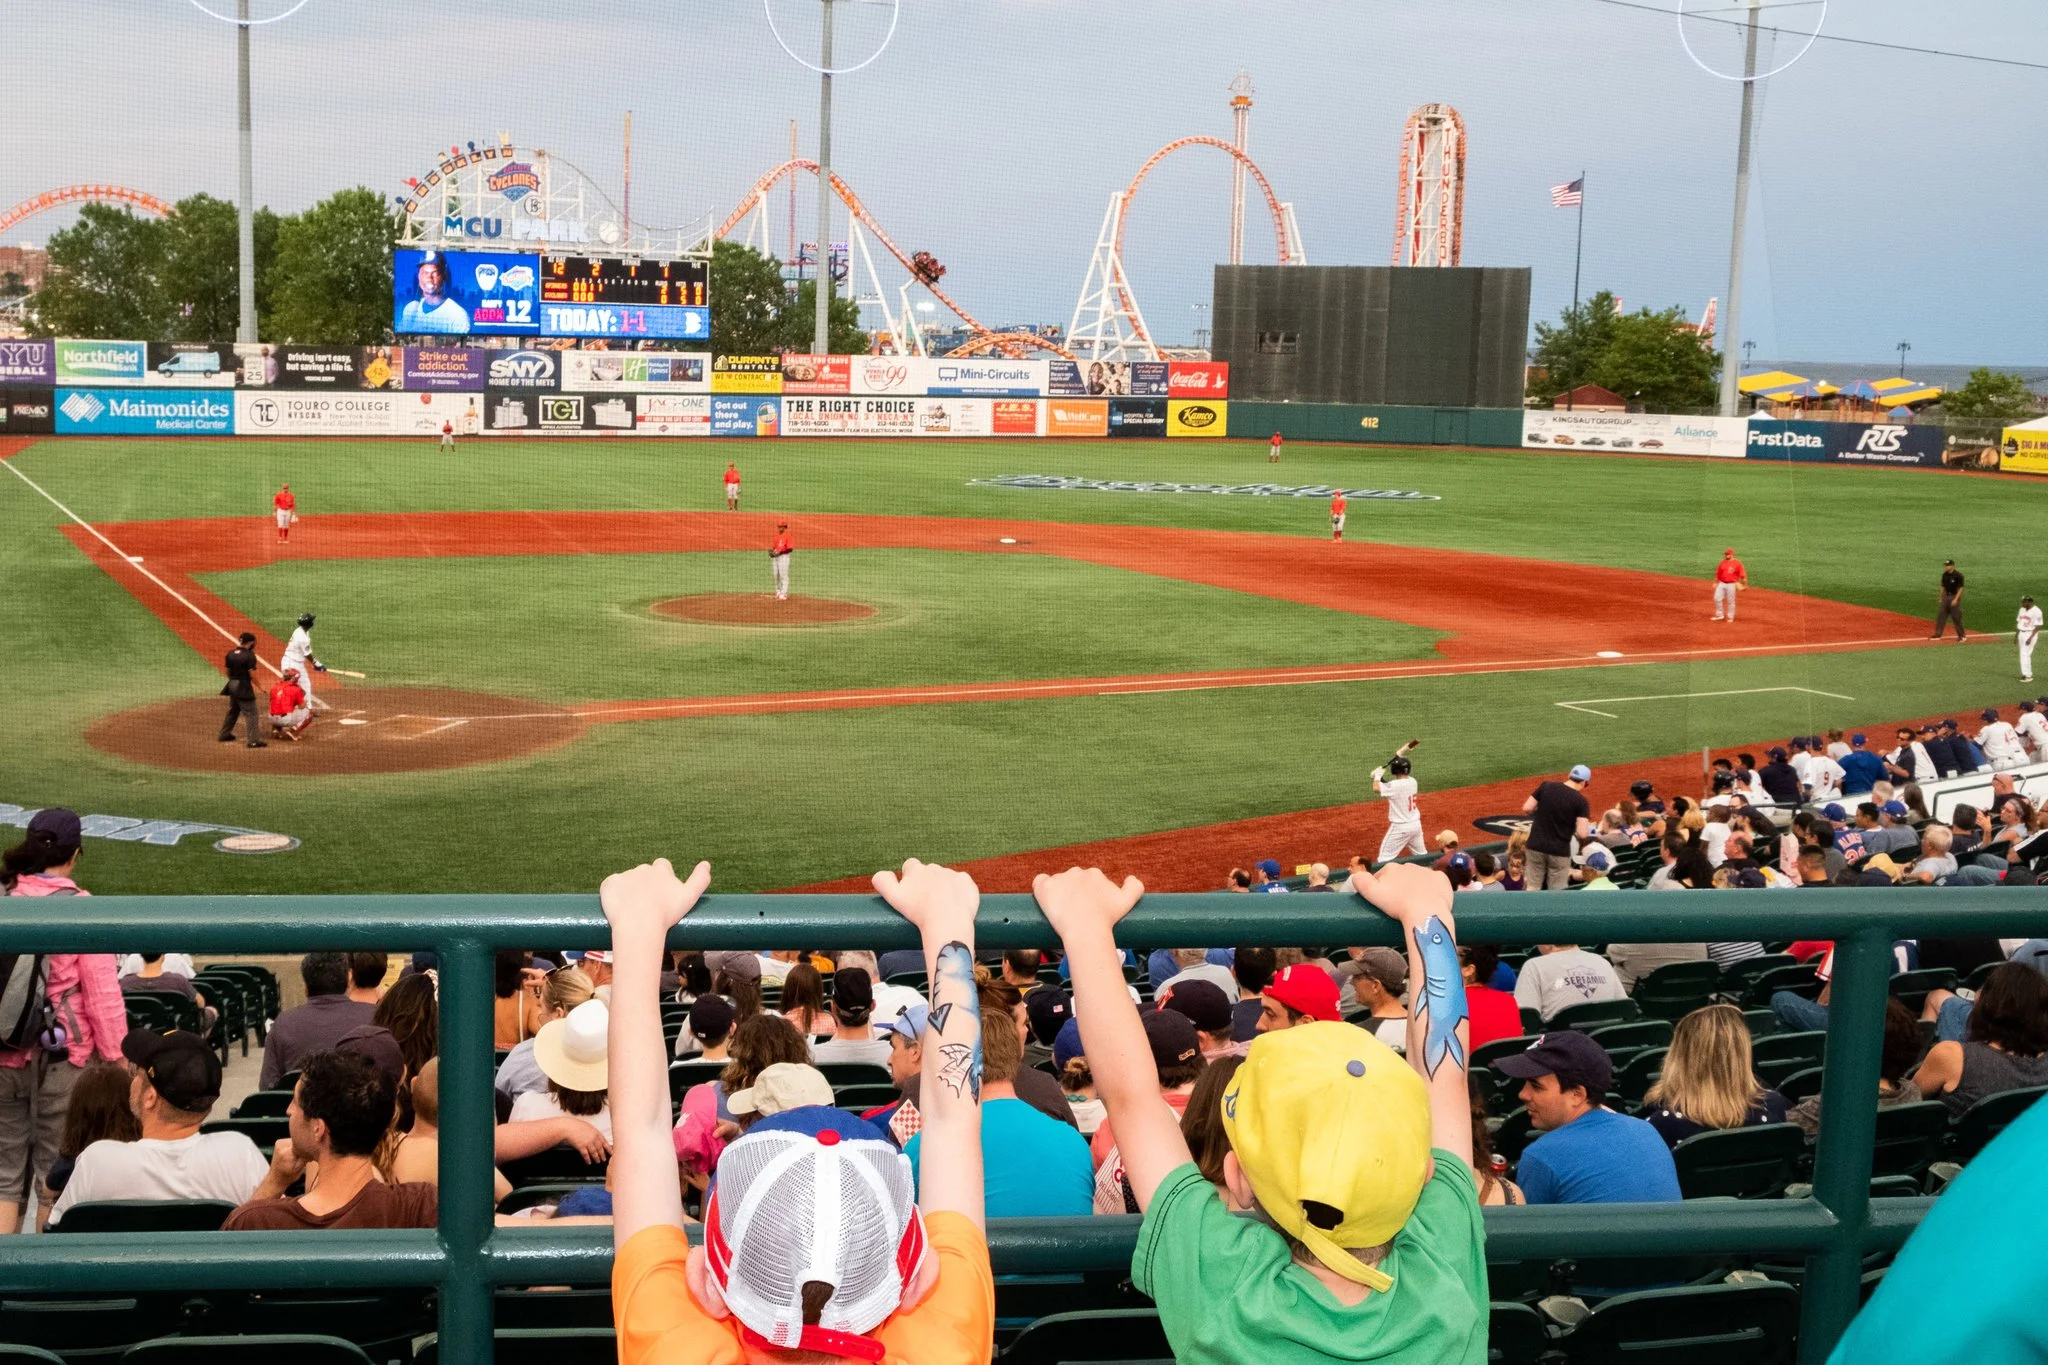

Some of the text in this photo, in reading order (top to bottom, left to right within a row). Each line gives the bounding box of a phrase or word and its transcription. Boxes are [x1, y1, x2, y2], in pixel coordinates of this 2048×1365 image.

[489, 173, 538, 191] CYCLONES
[444, 216, 589, 243] MCU PARK
[553, 262, 565, 275] 12
[592, 264, 600, 276] 2
[506, 300, 531, 322] 12
[548, 308, 648, 333] TODAY: 1-1
[0, 343, 45, 366] YU
[64, 350, 138, 363] Northfield
[288, 353, 314, 364] Driving
[418, 352, 468, 361] Strike out
[728, 356, 779, 364] DURANTE
[300, 364, 324, 372] saving
[418, 362, 468, 371] addiction.
[489, 360, 544, 378] SNY
[247, 372, 262, 381] 25
[408, 371, 480, 380] CombatAddiction.ny.gov
[960, 368, 1030, 380] Mini-Circuits
[536, 379, 556, 387] METS
[13, 406, 48, 415] PREMIO
[108, 398, 229, 416] Maimonides
[288, 401, 390, 412] TOURO COLLEGE
[715, 402, 730, 410] Get
[787, 401, 915, 412] THE RIGHT CHOICE
[1182, 407, 1214, 422] Kamco
[156, 420, 228, 429] Medical Center
[715, 420, 754, 430] and play.
[1361, 416, 1379, 428] 412
[1674, 425, 1718, 438] Alliance
[1748, 430, 1782, 446] First
[1856, 425, 1908, 452] RTS
[1888, 454, 1920, 462] Company
[1824, 771, 1830, 786] 9
